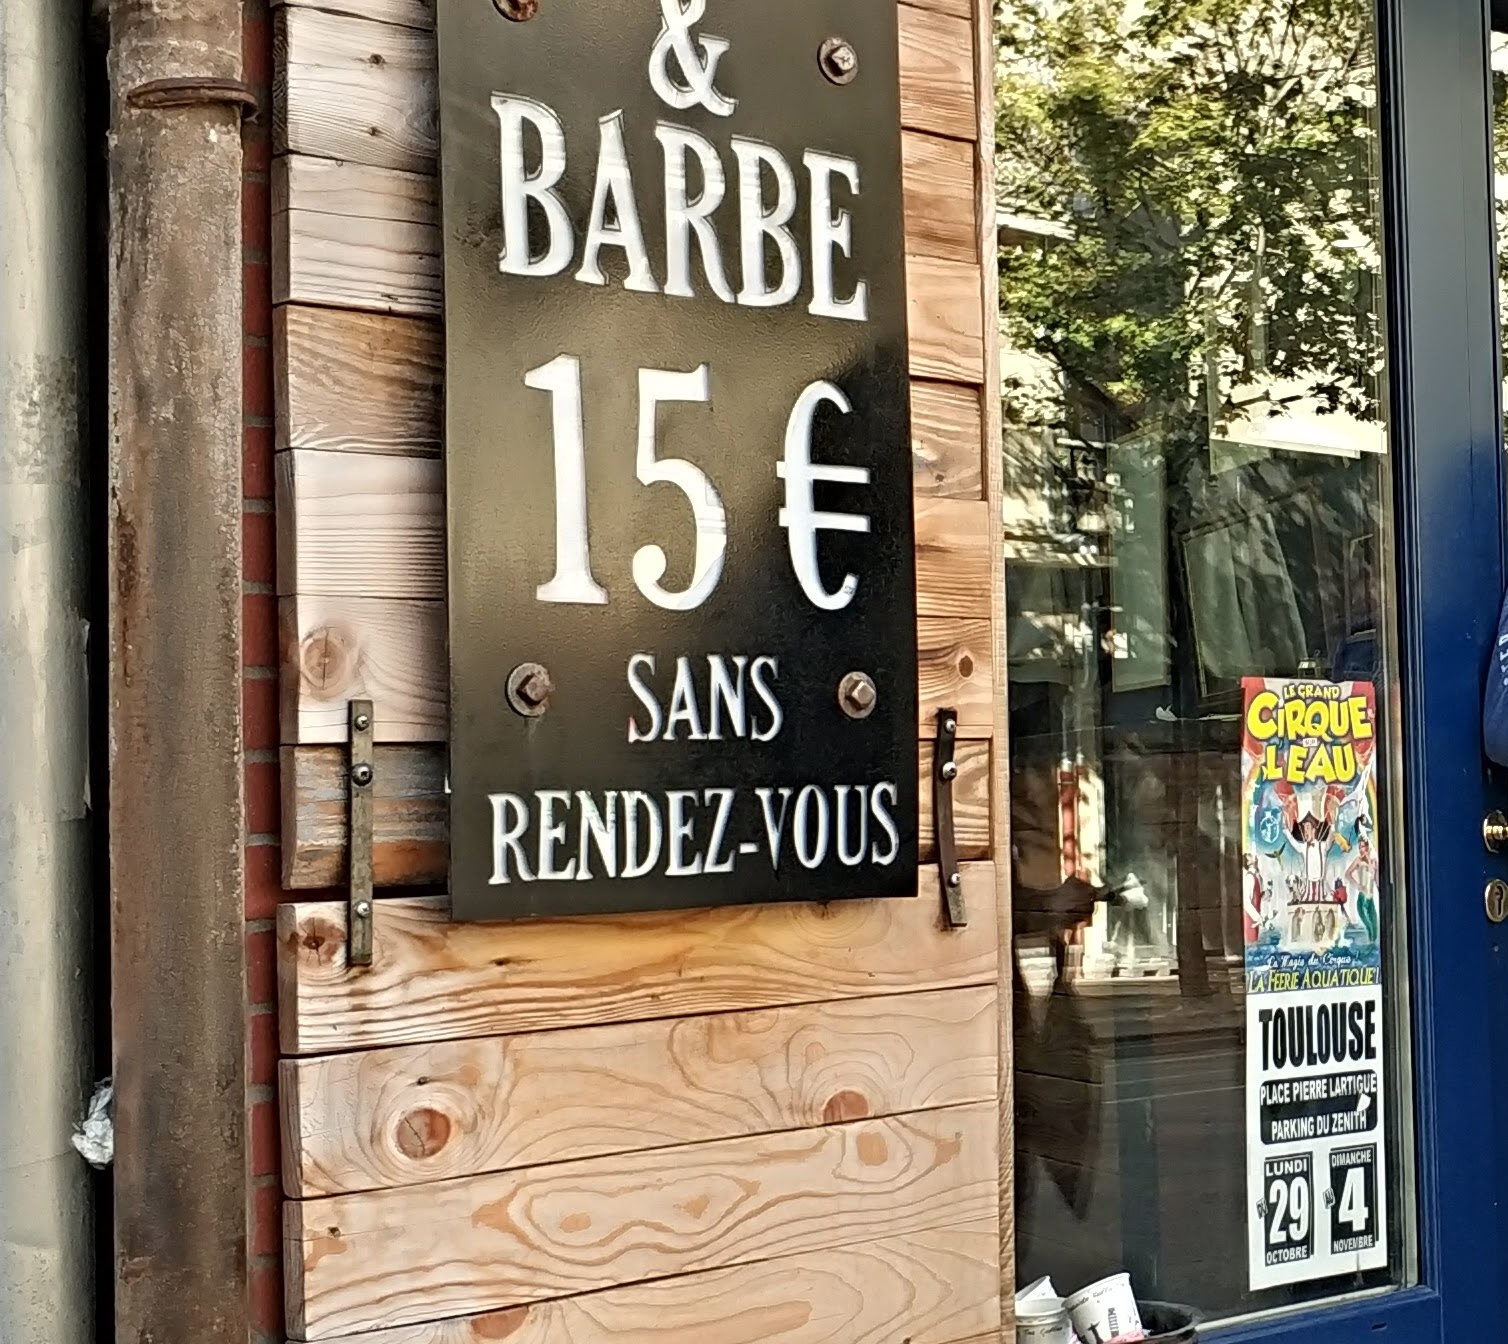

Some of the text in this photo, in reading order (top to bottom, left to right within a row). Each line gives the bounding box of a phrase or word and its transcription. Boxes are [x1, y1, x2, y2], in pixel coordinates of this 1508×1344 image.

[490, 90, 870, 322] BARBE
[524, 353, 871, 612] 15 €
[627, 652, 784, 743] SANS
[1283, 684, 1341, 699] LE GRAND
[488, 781, 900, 886] RENDEZ-VOUS
[1301, 966, 1374, 990] AQUATIQUE
[1259, 1000, 1376, 1071] TOULOUSE
[1260, 1073, 1377, 1106] PLACE PIERRE LARTIGUE
[1272, 1110, 1367, 1141] PARKING DU ZENITH
[1265, 1158, 1307, 1177] LUNDI
[1331, 1150, 1372, 1167] DIMANCHE
[1269, 1176, 1309, 1244] 29
[1339, 1166, 1369, 1232] 4
[1266, 1245, 1307, 1264] OCTOBRE
[1333, 1235, 1373, 1253] NOVEMBRE
